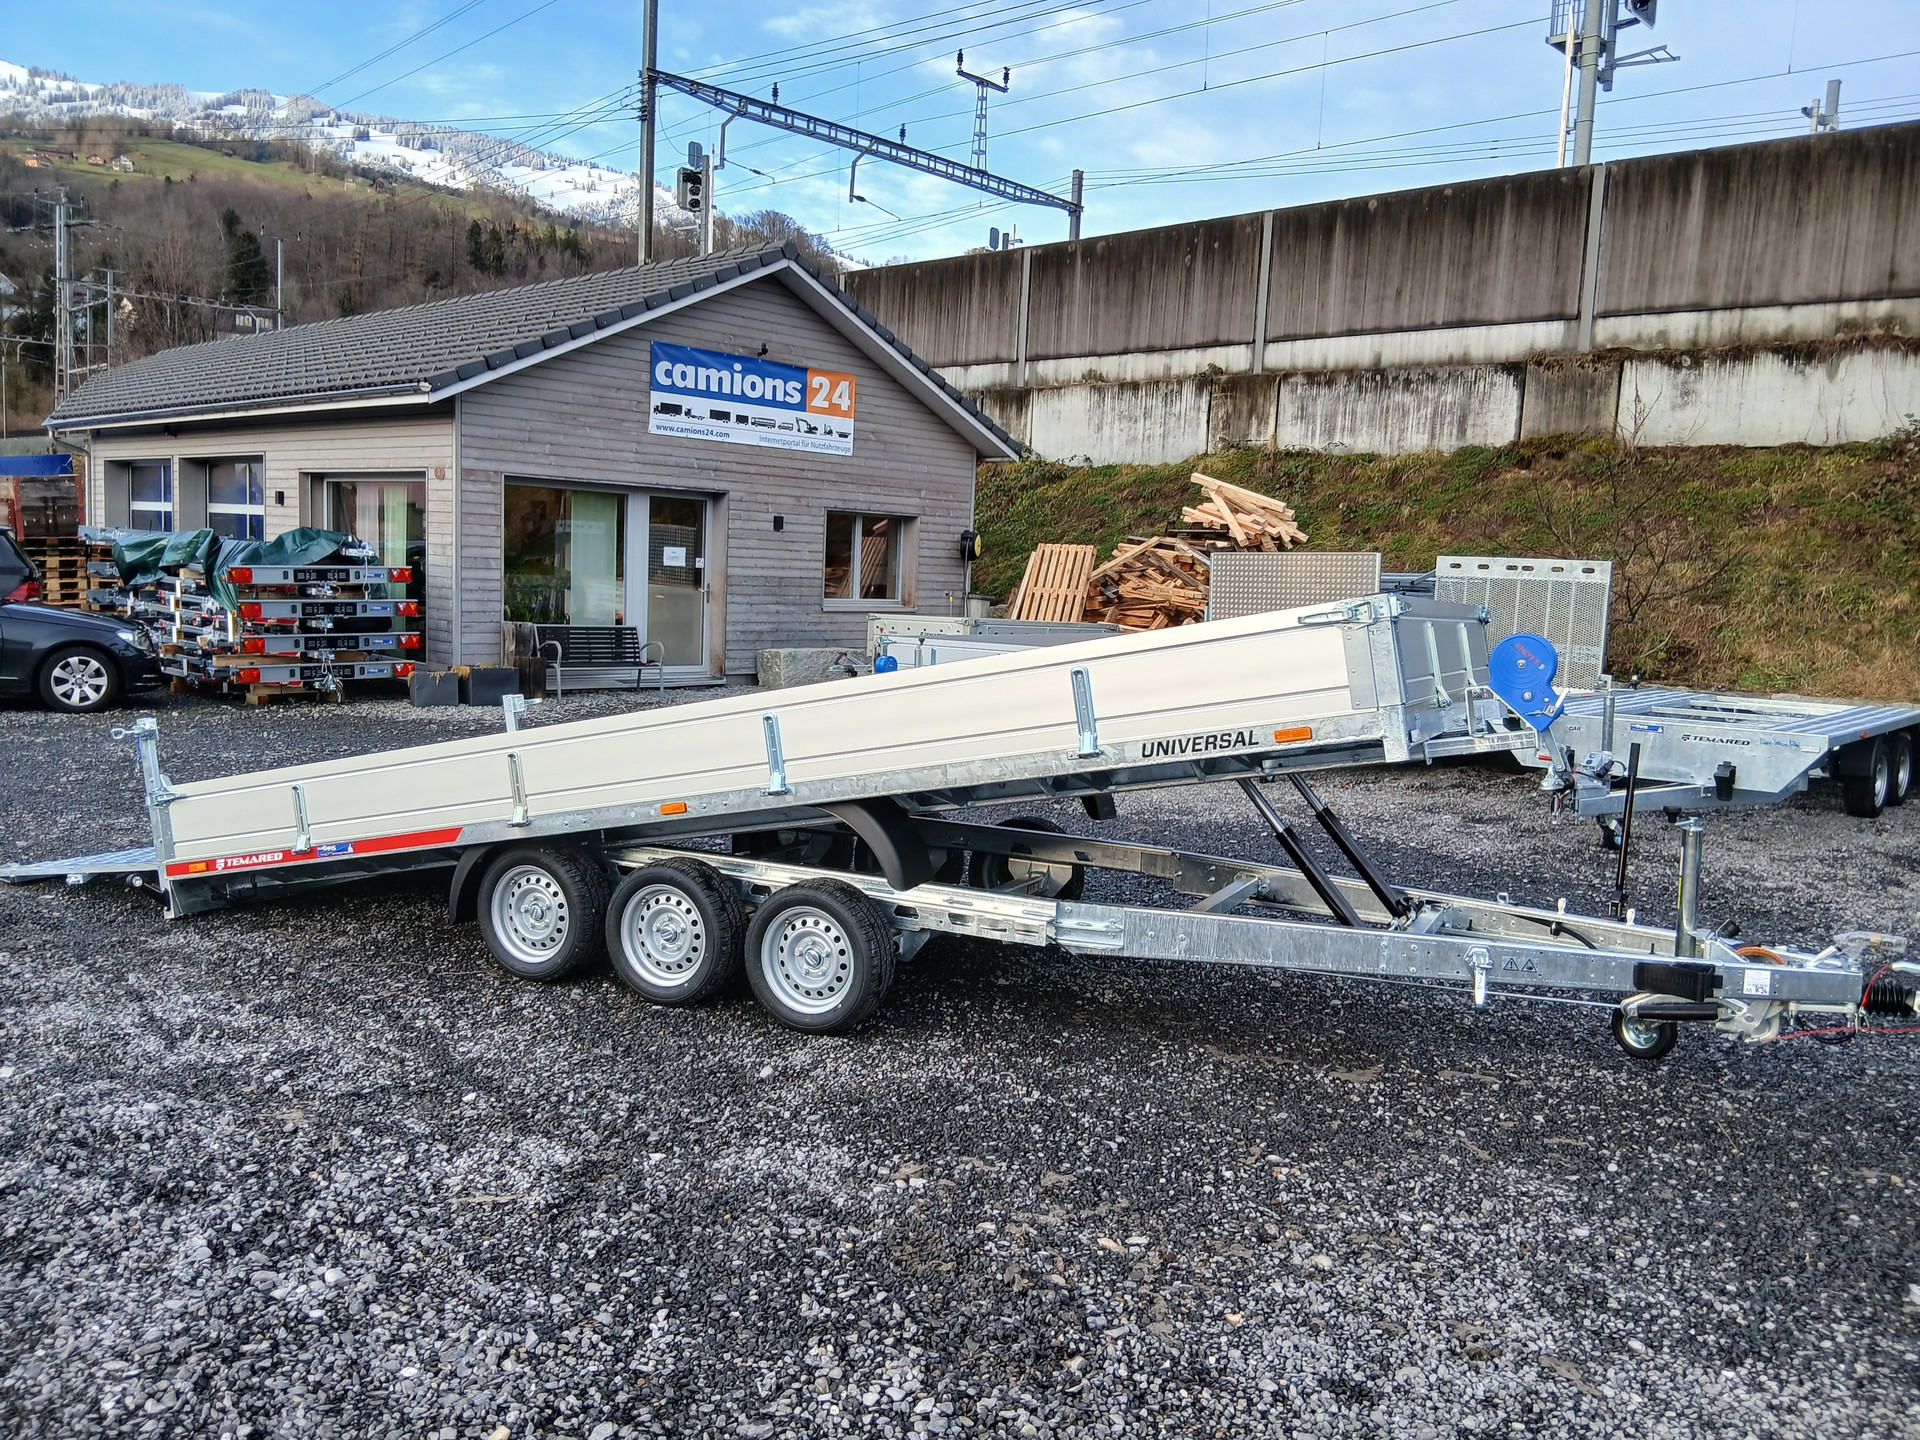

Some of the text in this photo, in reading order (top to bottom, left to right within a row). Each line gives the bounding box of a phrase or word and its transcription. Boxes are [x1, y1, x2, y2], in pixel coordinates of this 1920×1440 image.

[655, 361, 851, 411] camions 24
[655, 424, 730, 439] www.camions24.com
[759, 435, 852, 453] Internetportal für Nutzfahrzeuge
[1141, 730, 1260, 758] UNIVERSAL
[1692, 735, 1751, 746] TEMARED
[226, 852, 284, 867] TEMARED
